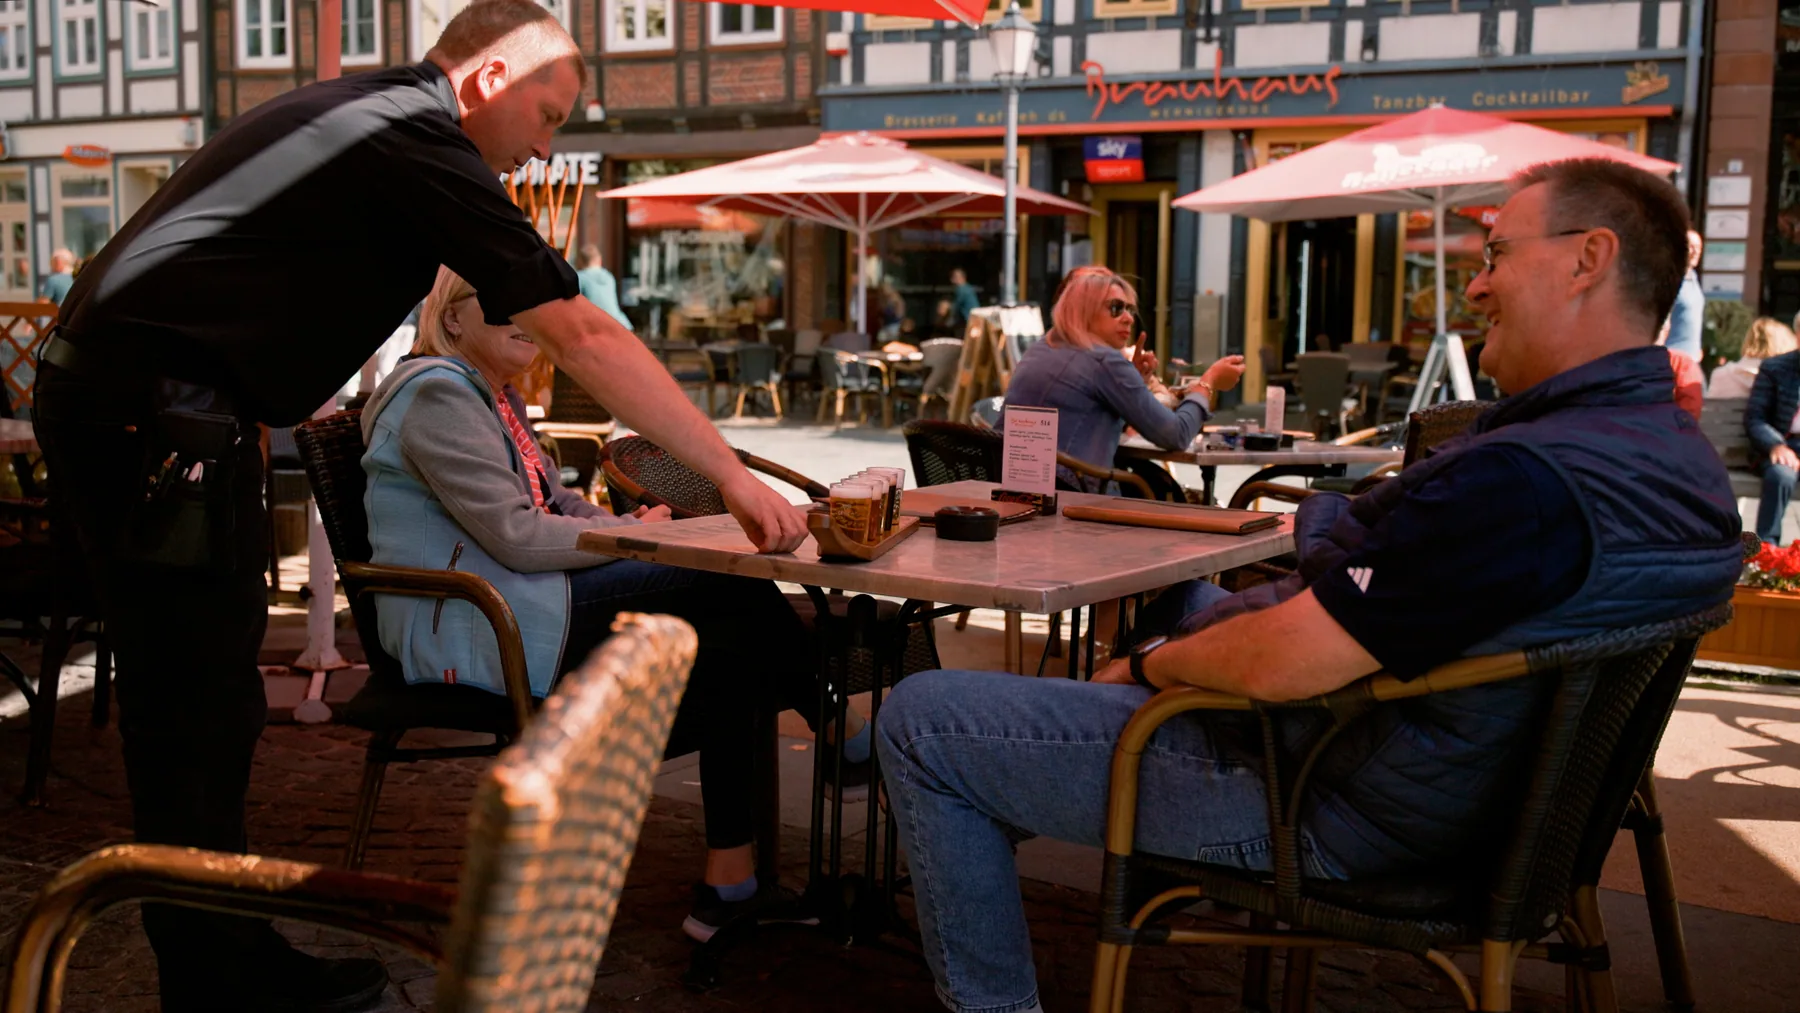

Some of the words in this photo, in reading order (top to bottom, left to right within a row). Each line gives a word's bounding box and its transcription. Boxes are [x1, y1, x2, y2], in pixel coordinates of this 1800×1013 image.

[1081, 49, 1342, 121] Brauhaus
[1472, 89, 1591, 106] Cocktailbar
[1096, 138, 1129, 159] sky
